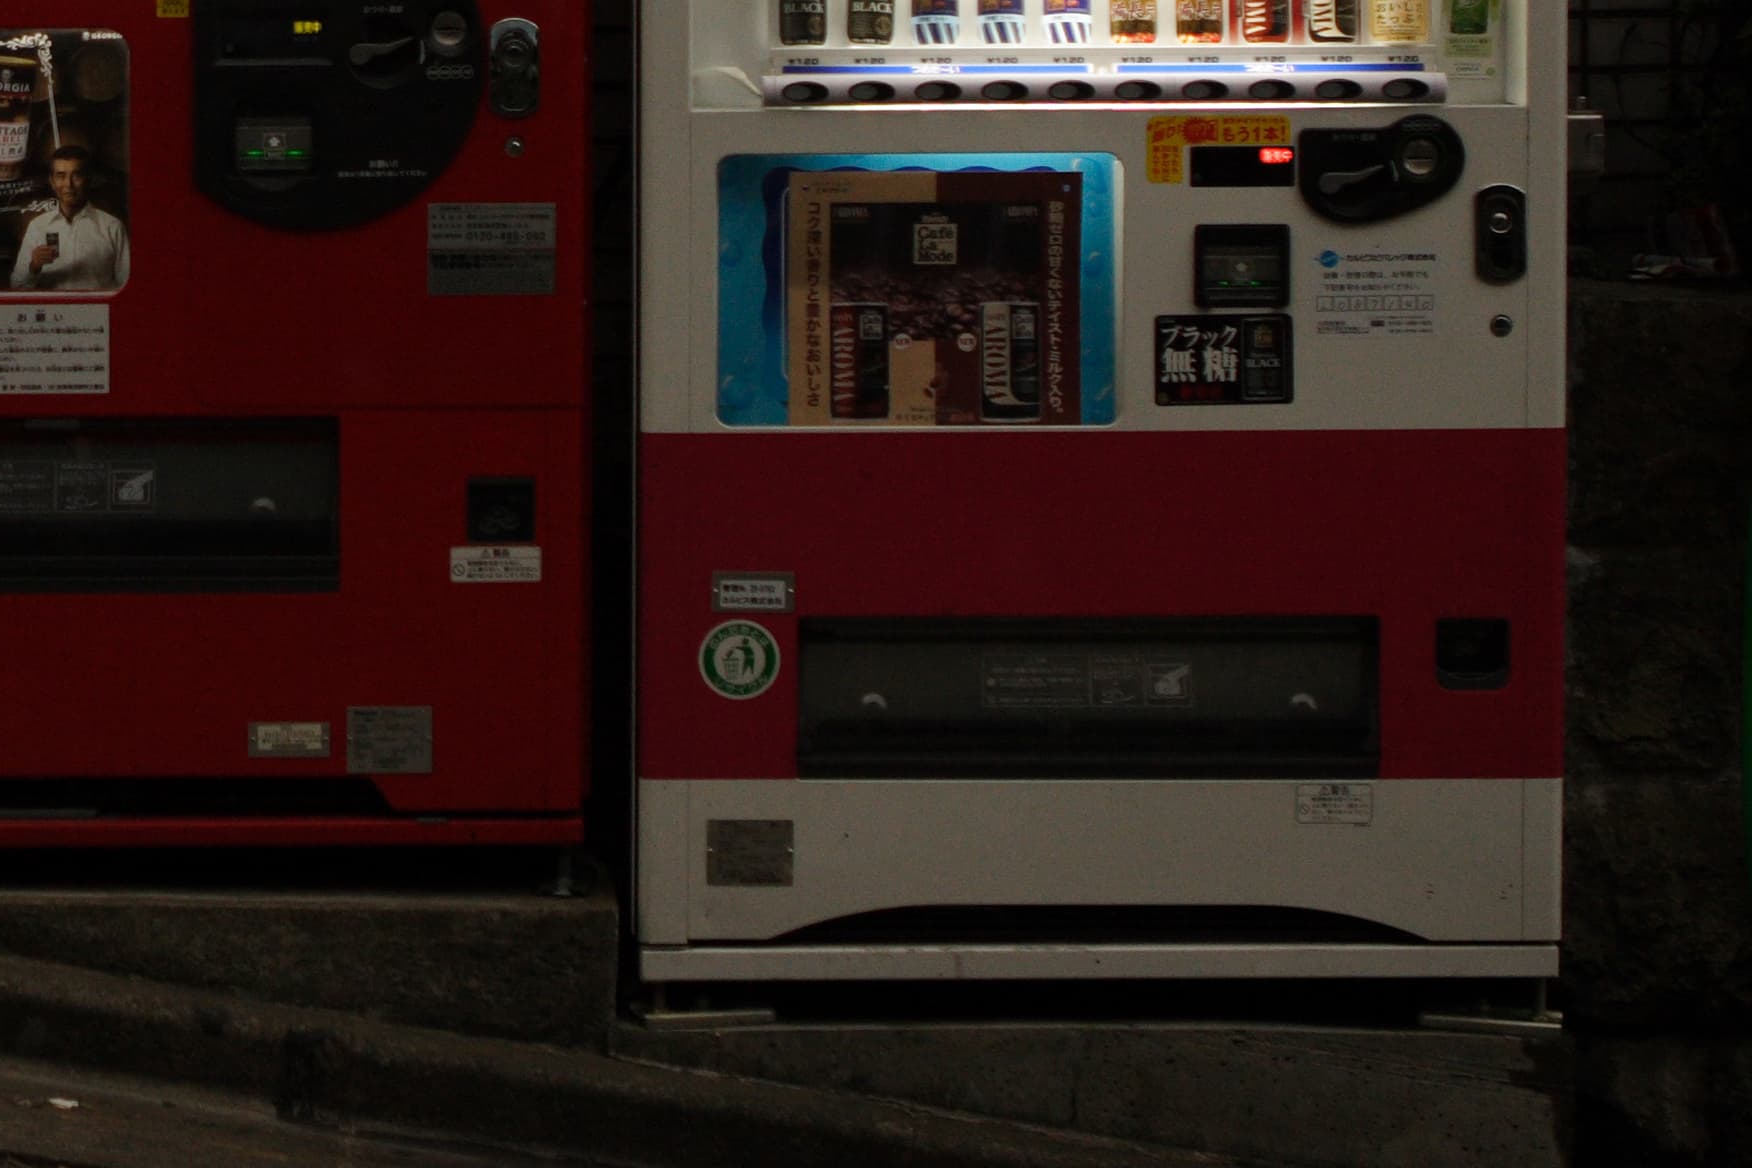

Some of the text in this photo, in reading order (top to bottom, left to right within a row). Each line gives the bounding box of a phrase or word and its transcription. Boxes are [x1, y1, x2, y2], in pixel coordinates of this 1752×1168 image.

[783, 2, 825, 14] BLACK
[851, 1, 894, 13] BLACK
[918, 226, 954, 240] Café
[917, 250, 954, 262] Mode
[1161, 326, 1238, 348] ブラック
[1160, 346, 1239, 383] 無糖
[1245, 359, 1280, 367] BLACK
